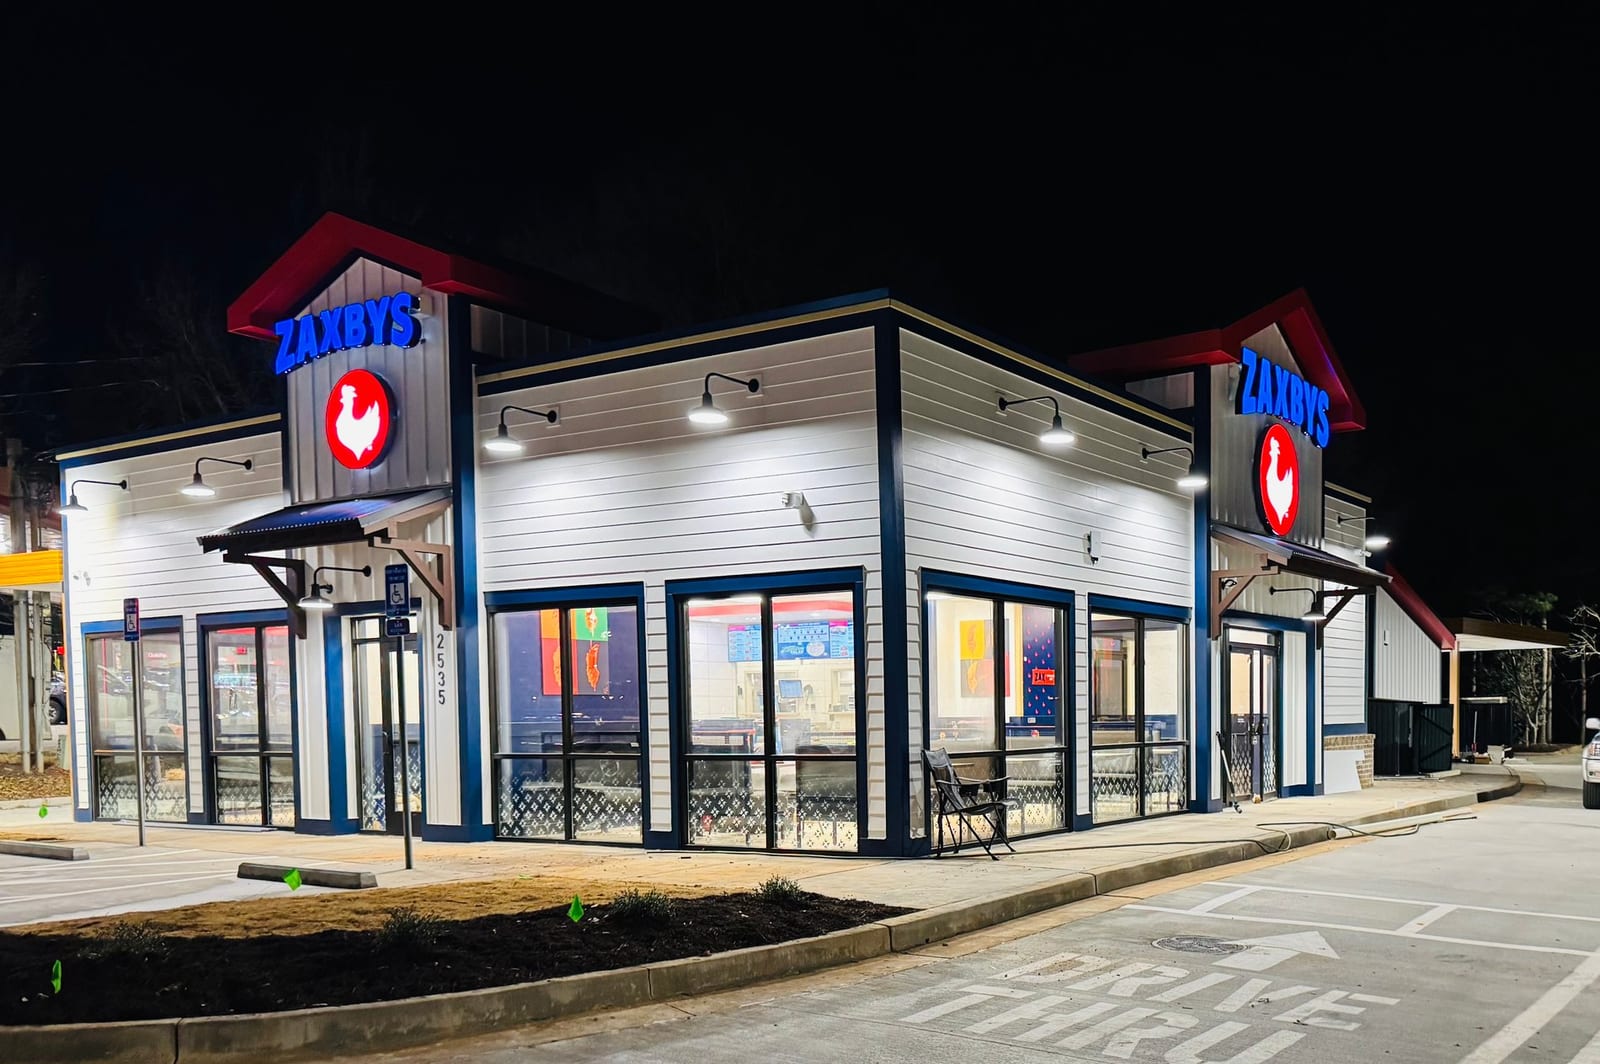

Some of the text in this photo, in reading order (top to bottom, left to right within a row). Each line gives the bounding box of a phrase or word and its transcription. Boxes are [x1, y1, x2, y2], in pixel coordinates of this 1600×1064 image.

[275, 292, 417, 375] ZAXBYS
[1240, 346, 1331, 449] ZAXBYS
[437, 633, 446, 705] 2535
[899, 984, 1307, 1064] THRU
[988, 953, 1400, 1031] DRIVE
